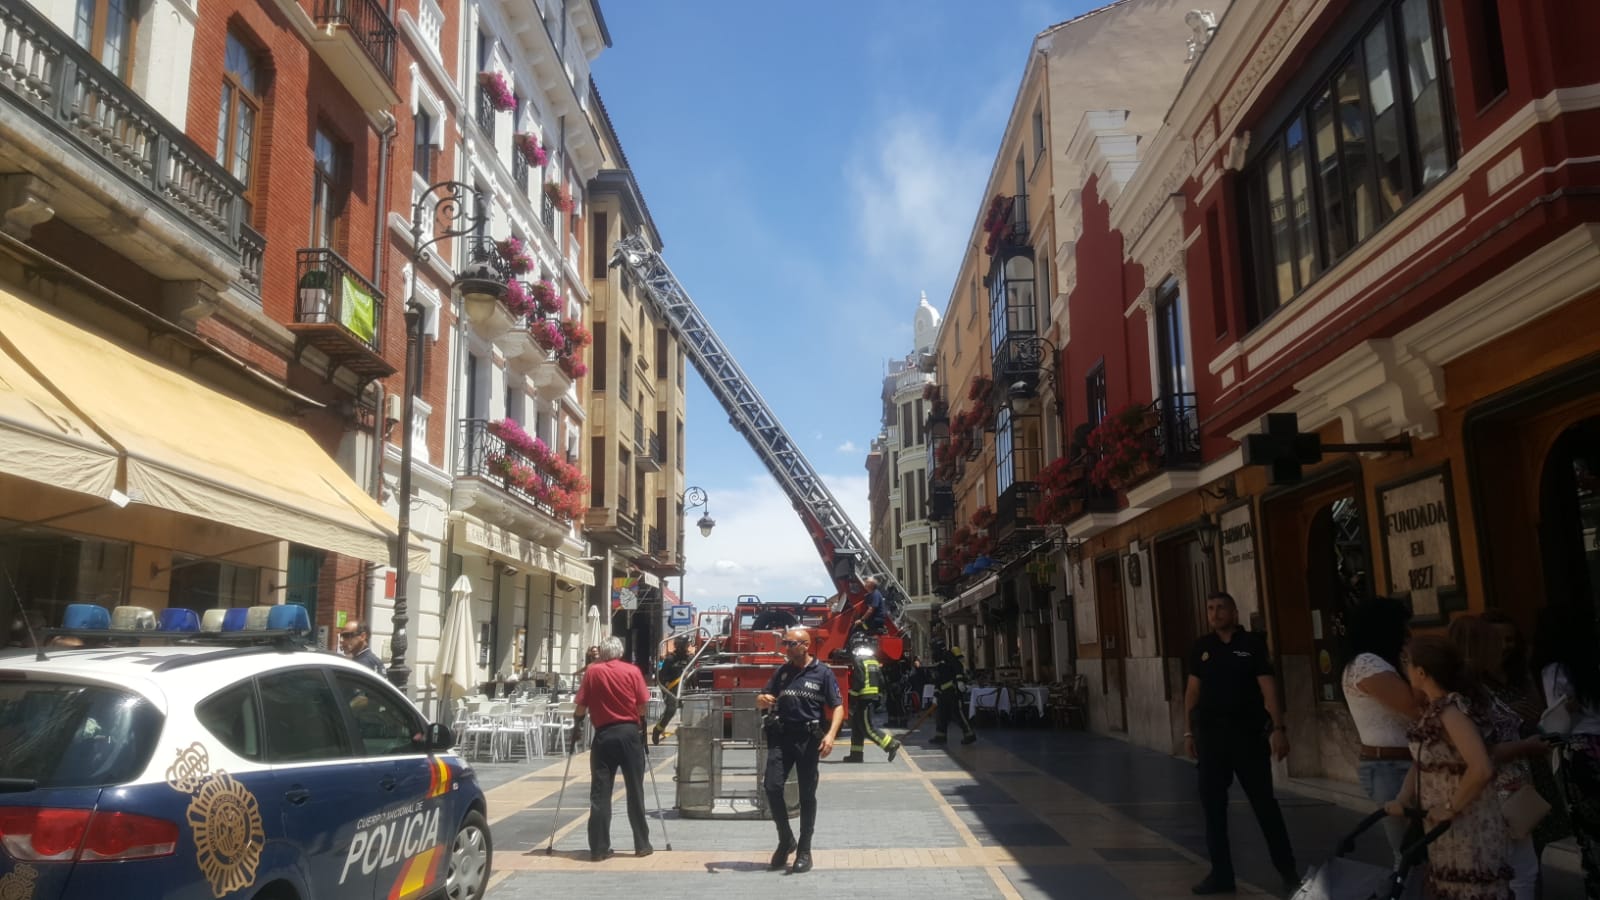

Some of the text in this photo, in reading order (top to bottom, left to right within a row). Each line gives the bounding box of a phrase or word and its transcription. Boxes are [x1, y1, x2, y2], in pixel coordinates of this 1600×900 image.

[1386, 501, 1447, 535] FUNDADA
[1411, 541, 1424, 557] EN
[415, 801, 425, 812] DE
[338, 807, 440, 885] POLICIA
